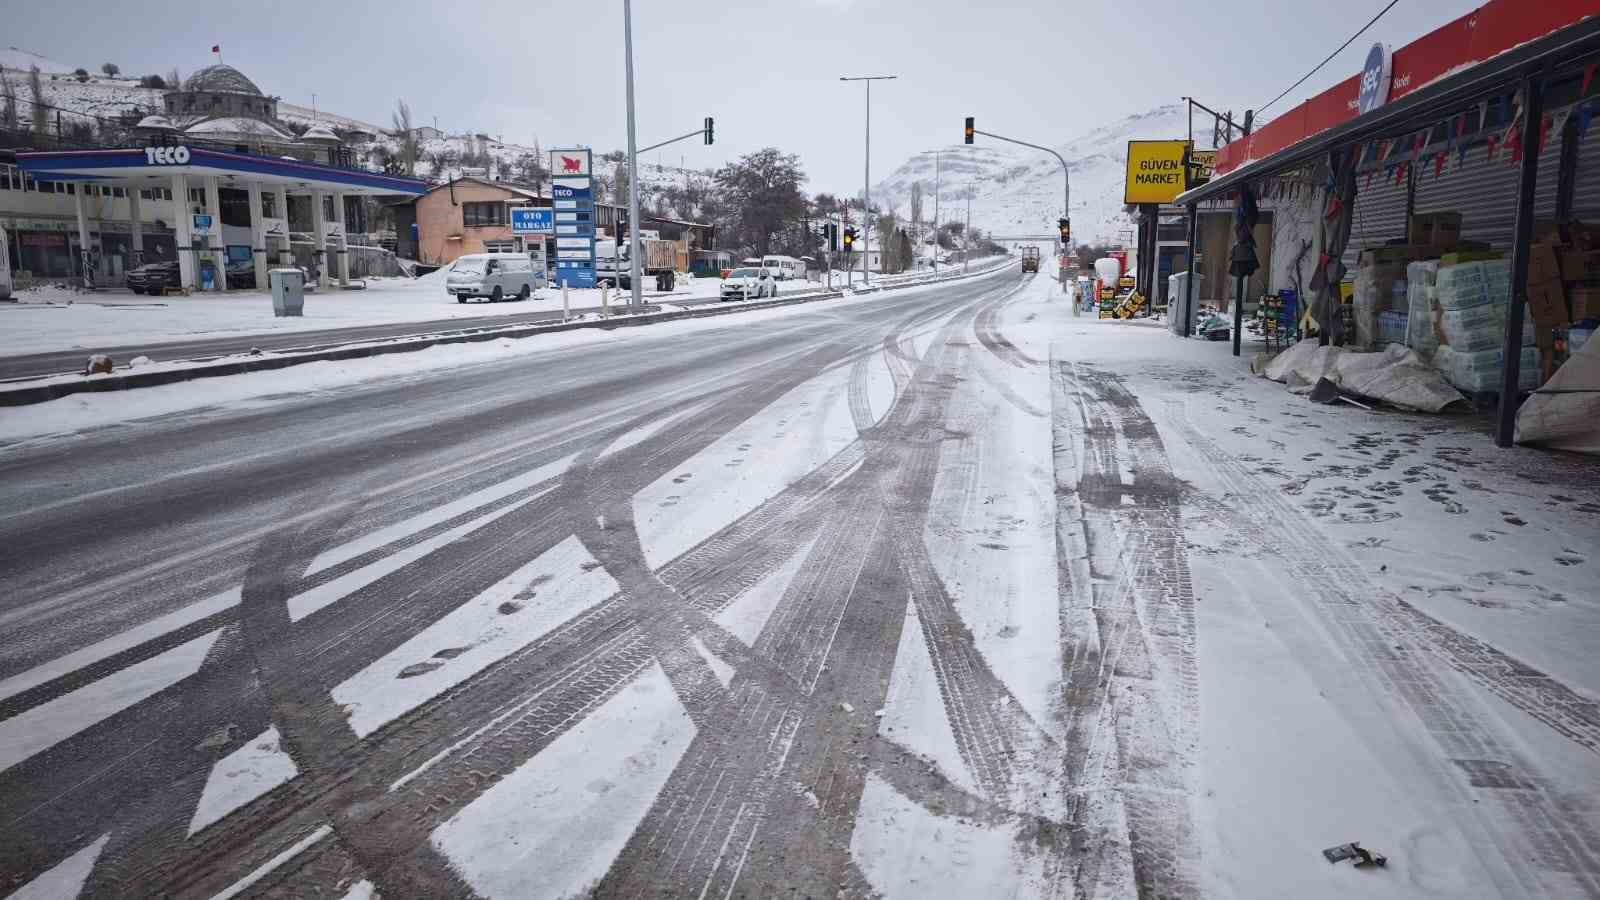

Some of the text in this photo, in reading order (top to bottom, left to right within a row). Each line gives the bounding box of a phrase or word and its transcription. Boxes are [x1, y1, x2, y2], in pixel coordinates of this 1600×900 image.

[145, 146, 190, 164] TECO
[1135, 173, 1182, 184] MARKET
[554, 189, 573, 197] TECO
